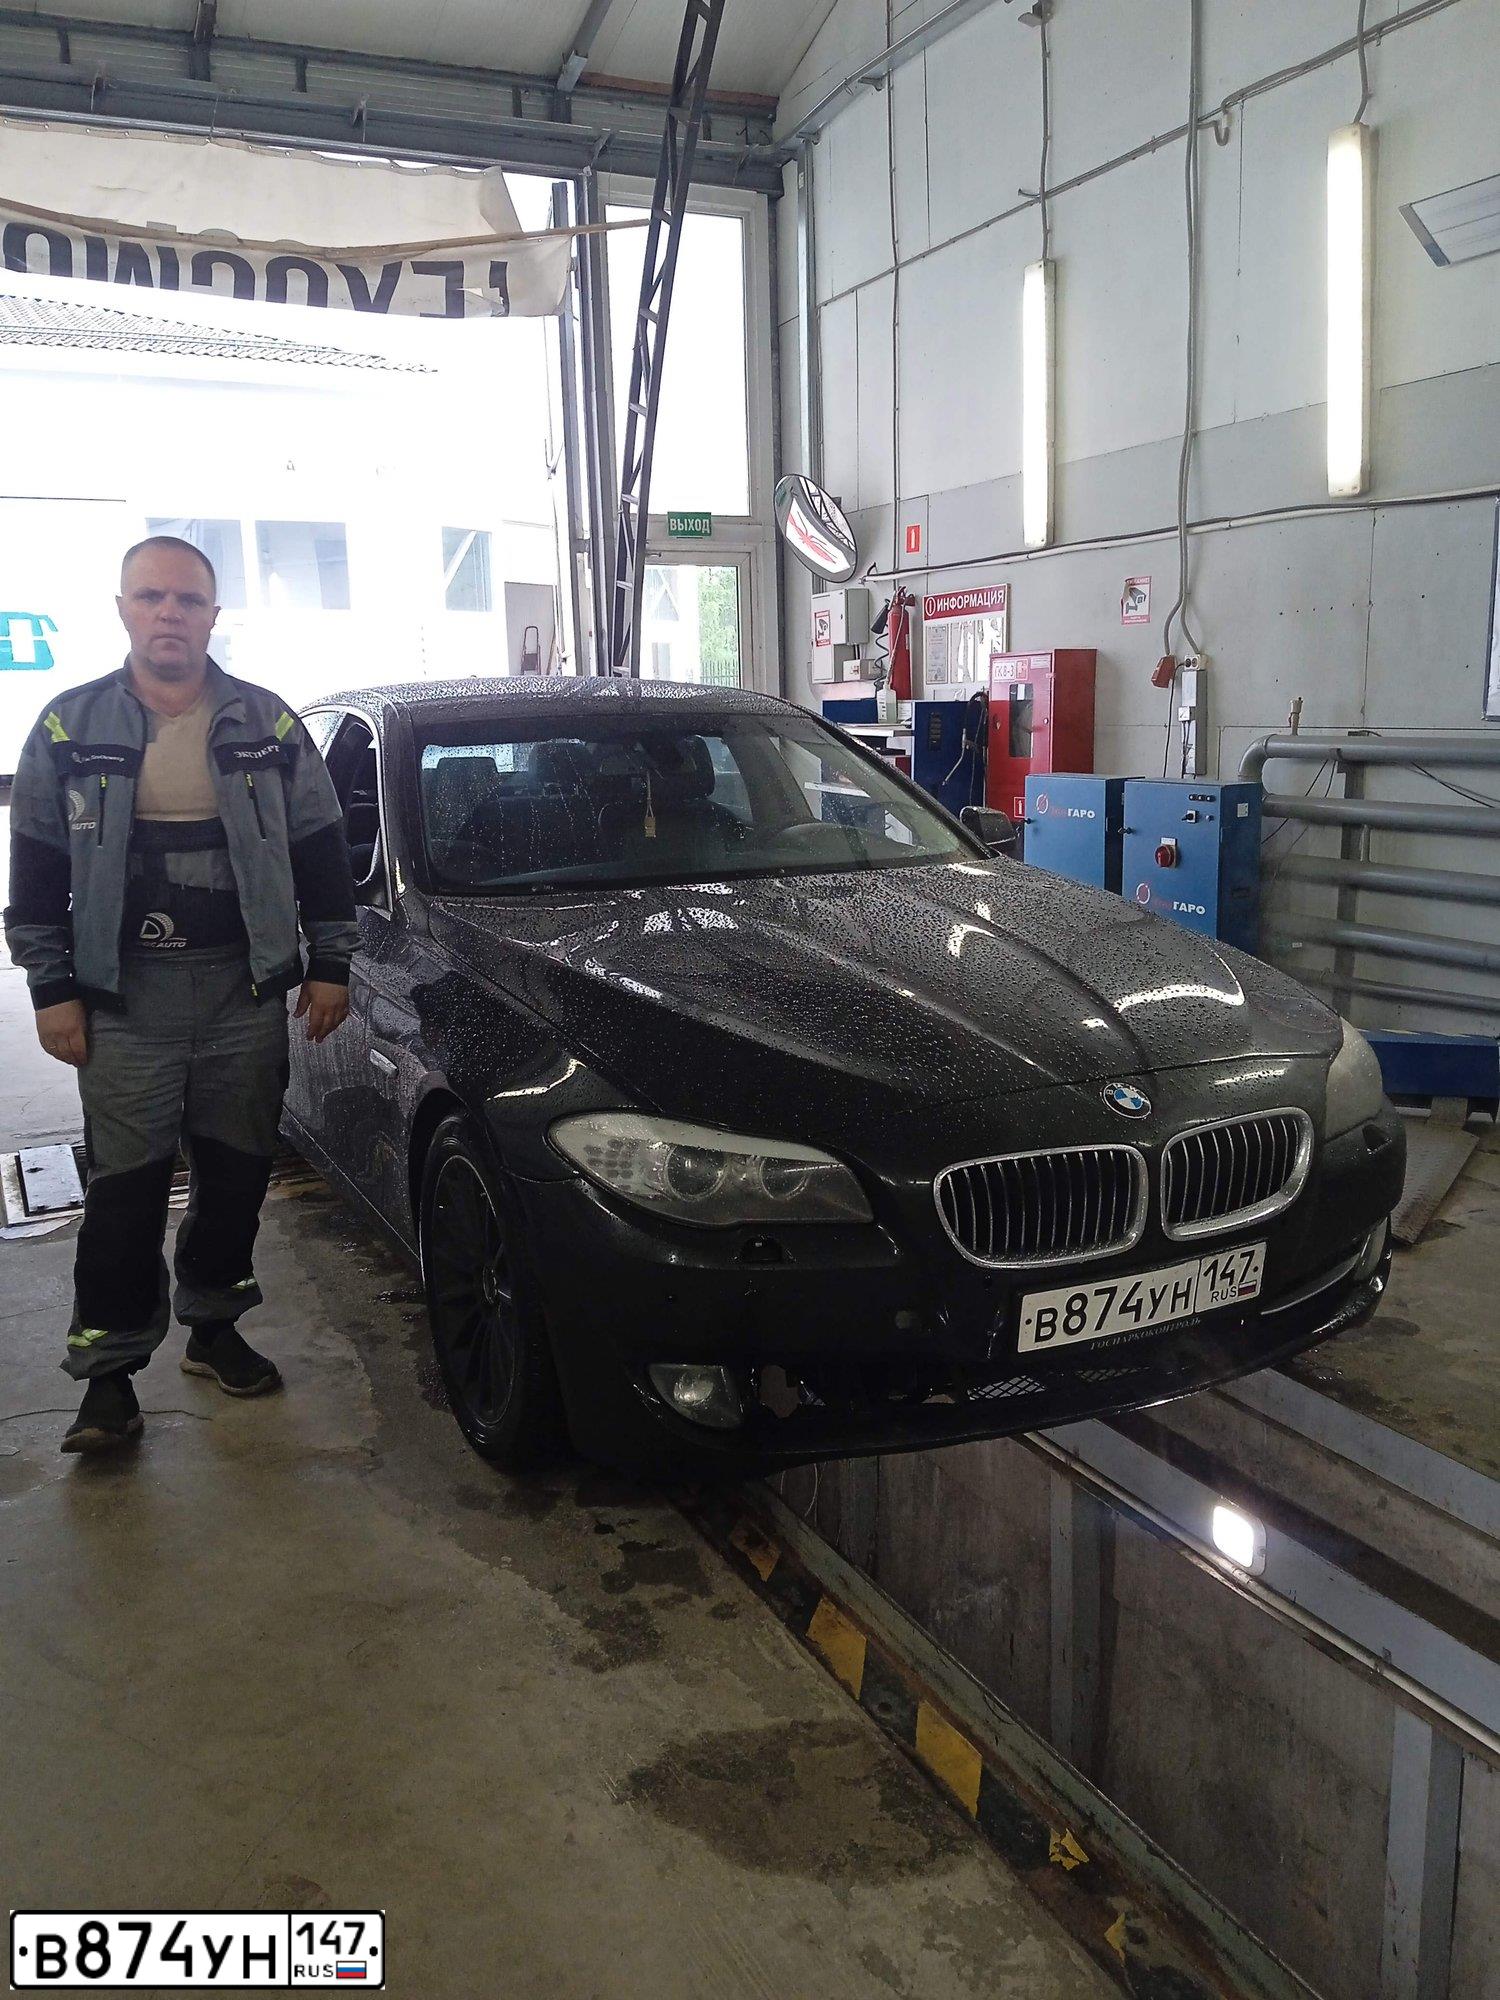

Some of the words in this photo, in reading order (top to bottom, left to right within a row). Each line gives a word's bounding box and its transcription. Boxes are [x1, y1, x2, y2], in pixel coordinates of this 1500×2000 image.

[670, 518, 710, 534] ВЫХОД
[936, 589, 1004, 612] ИНФОРМАЦИЯ
[233, 744, 280, 759] ЭКСПЕРТ
[1034, 1280, 1191, 1342] В874УН
[1203, 1251, 1254, 1290] 147
[1211, 1284, 1237, 1303] RUS
[1090, 1317, 1201, 1351] ГОСНАРКОКОНТРОЛЬ
